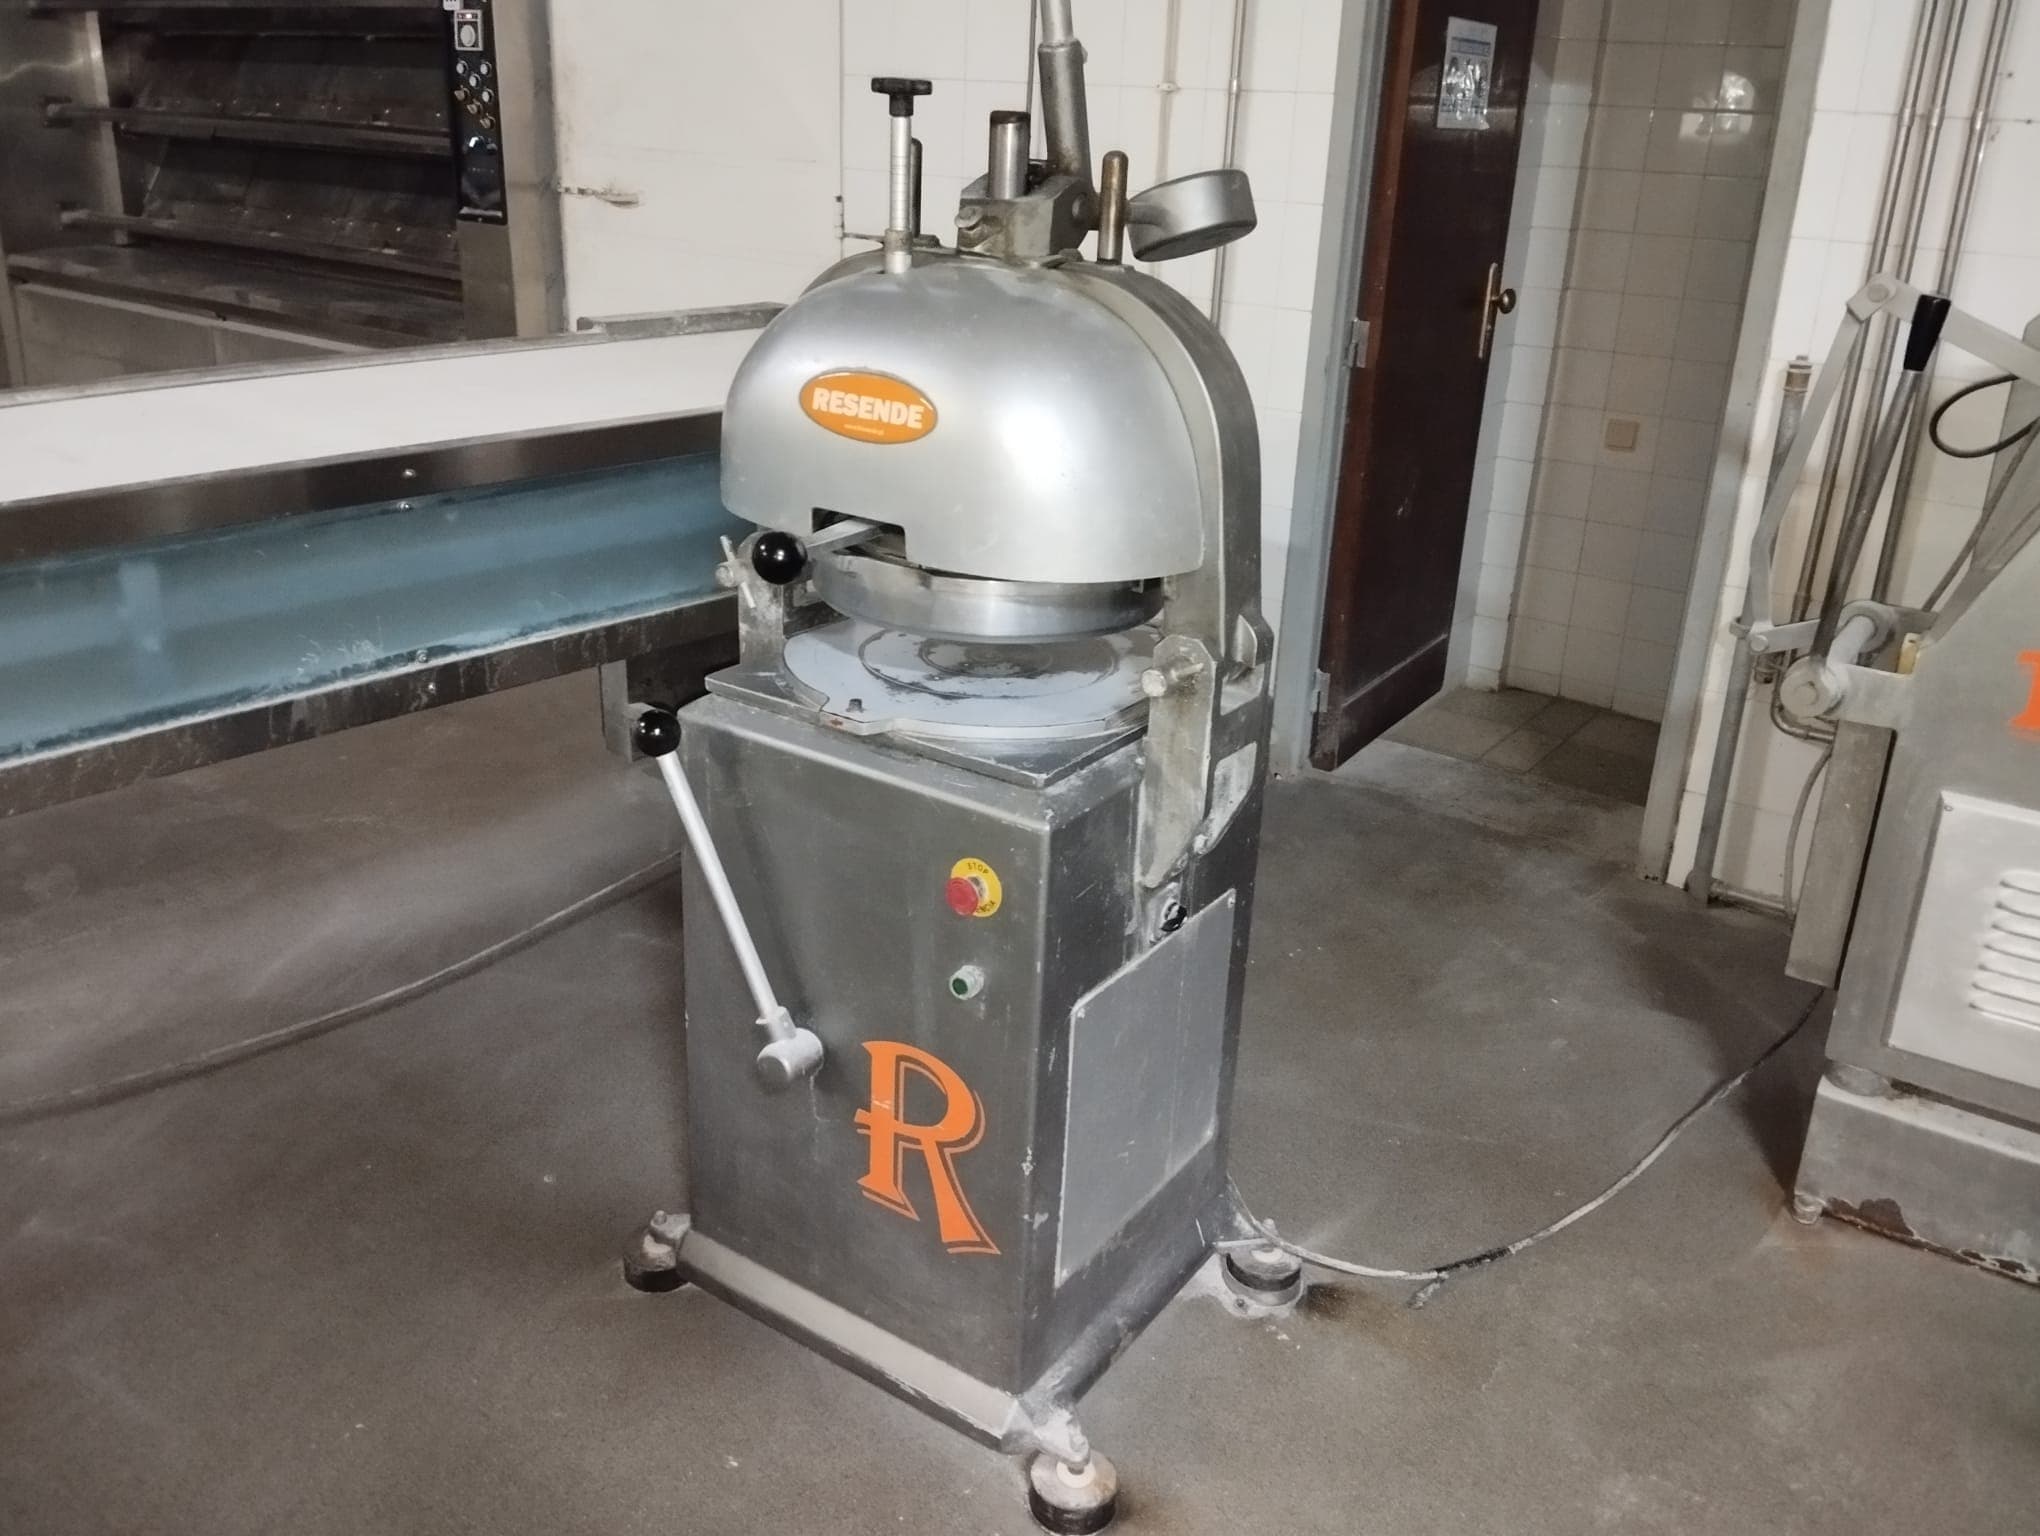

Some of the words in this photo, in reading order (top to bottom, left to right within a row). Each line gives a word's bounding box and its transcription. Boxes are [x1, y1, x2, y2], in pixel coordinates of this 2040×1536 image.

[812, 387, 925, 429] RESENDE
[967, 862, 989, 874] STOP
[854, 1040, 1001, 1255] R
